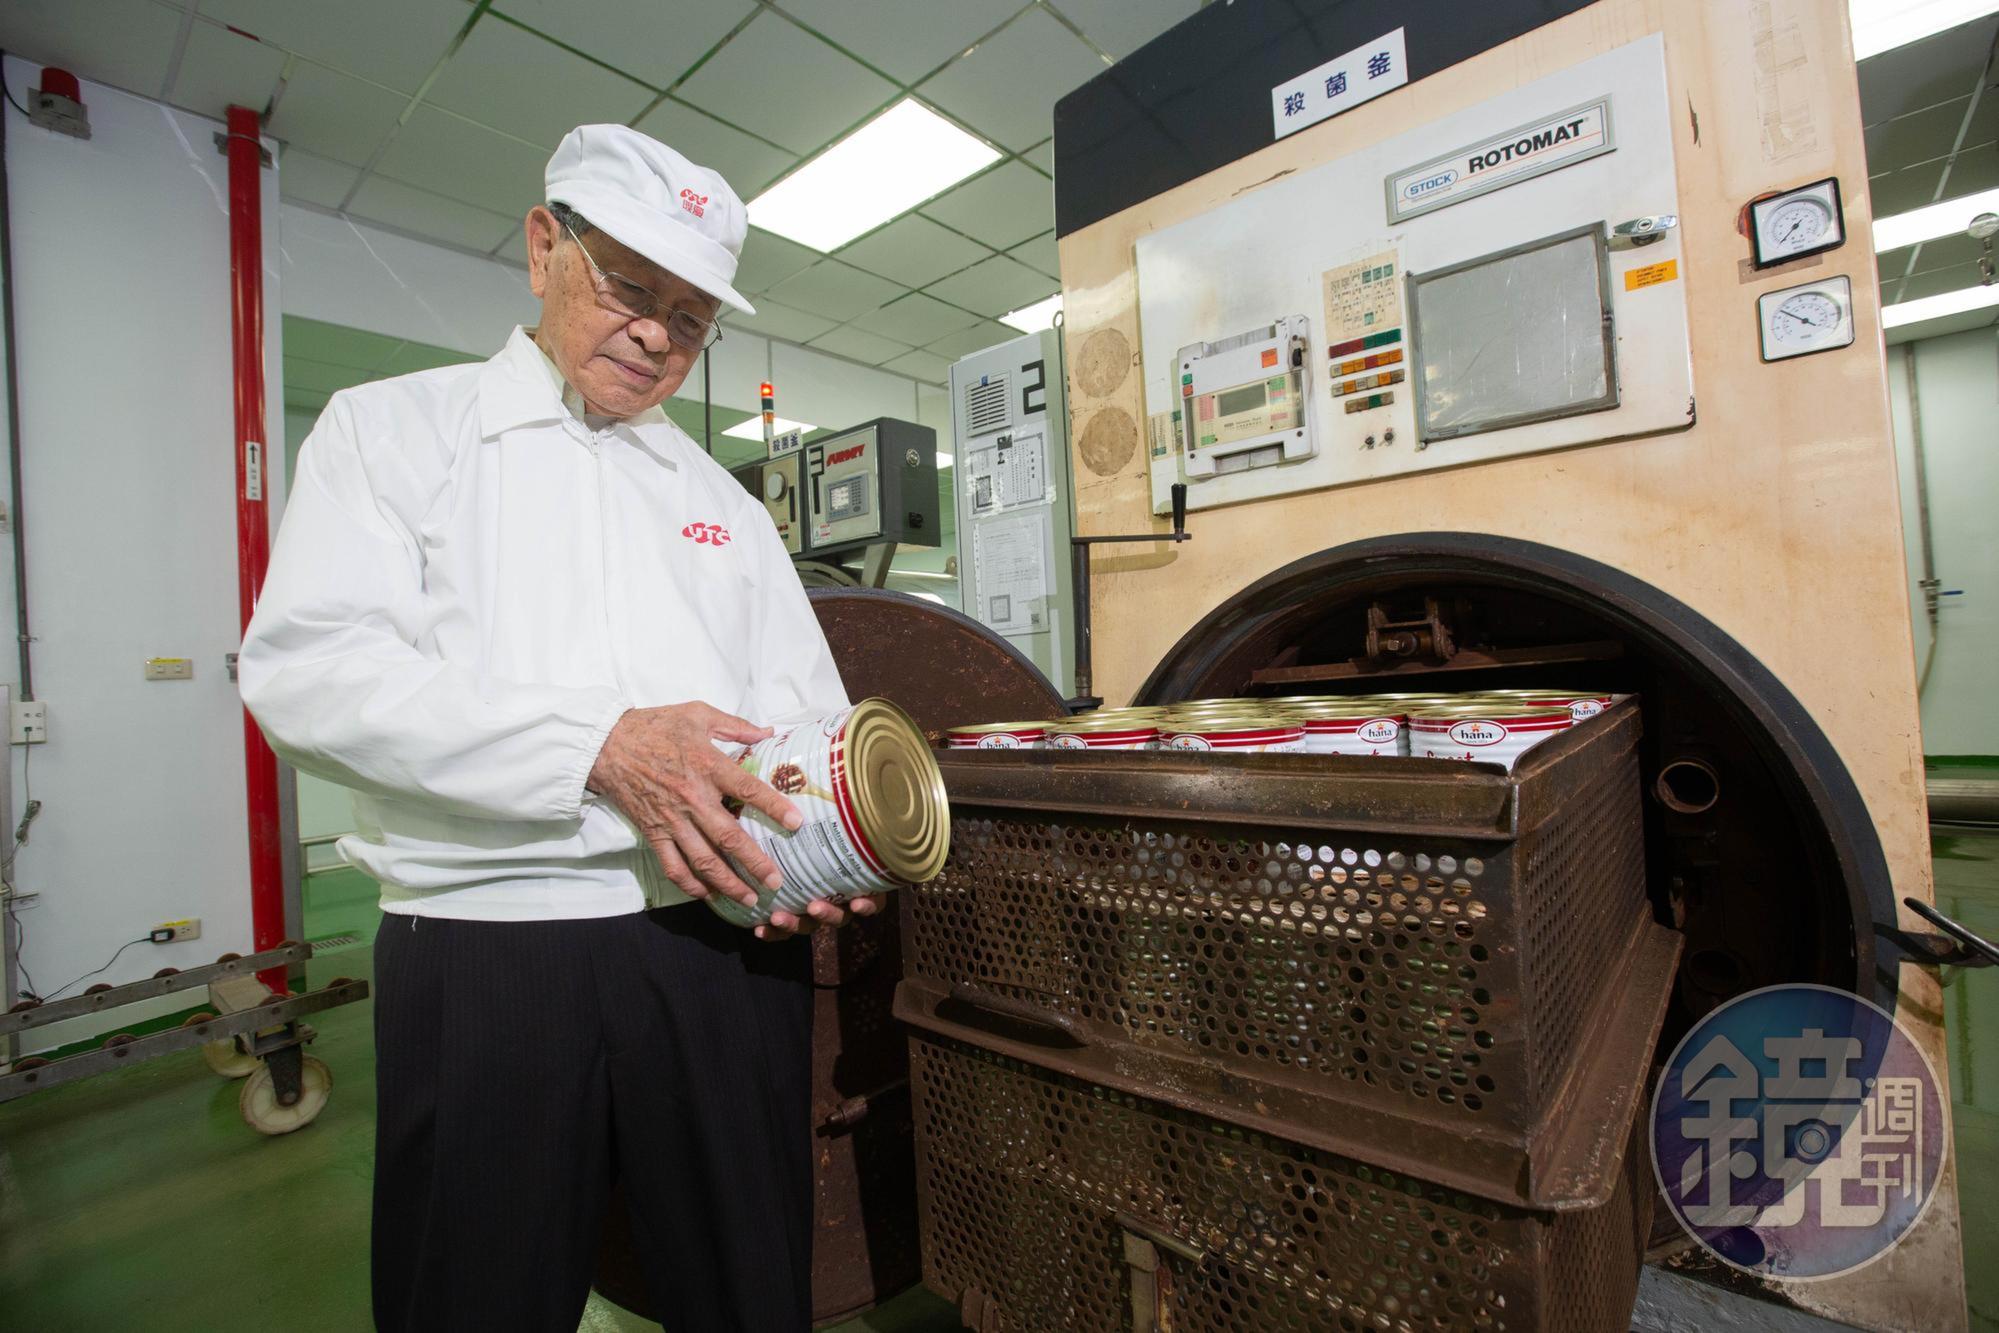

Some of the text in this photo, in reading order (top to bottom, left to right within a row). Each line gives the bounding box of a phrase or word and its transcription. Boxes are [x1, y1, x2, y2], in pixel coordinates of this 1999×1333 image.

[1284, 51, 1391, 117] 殺菌釜
[1469, 119, 1584, 174] ROTOMAT
[1410, 174, 1452, 196] STOCK
[1021, 359, 1047, 415] 2
[1575, 708, 1596, 716] hana
[1369, 729, 1392, 738] hana
[1461, 730, 1492, 739] hana
[832, 821, 849, 853] Nutrition
